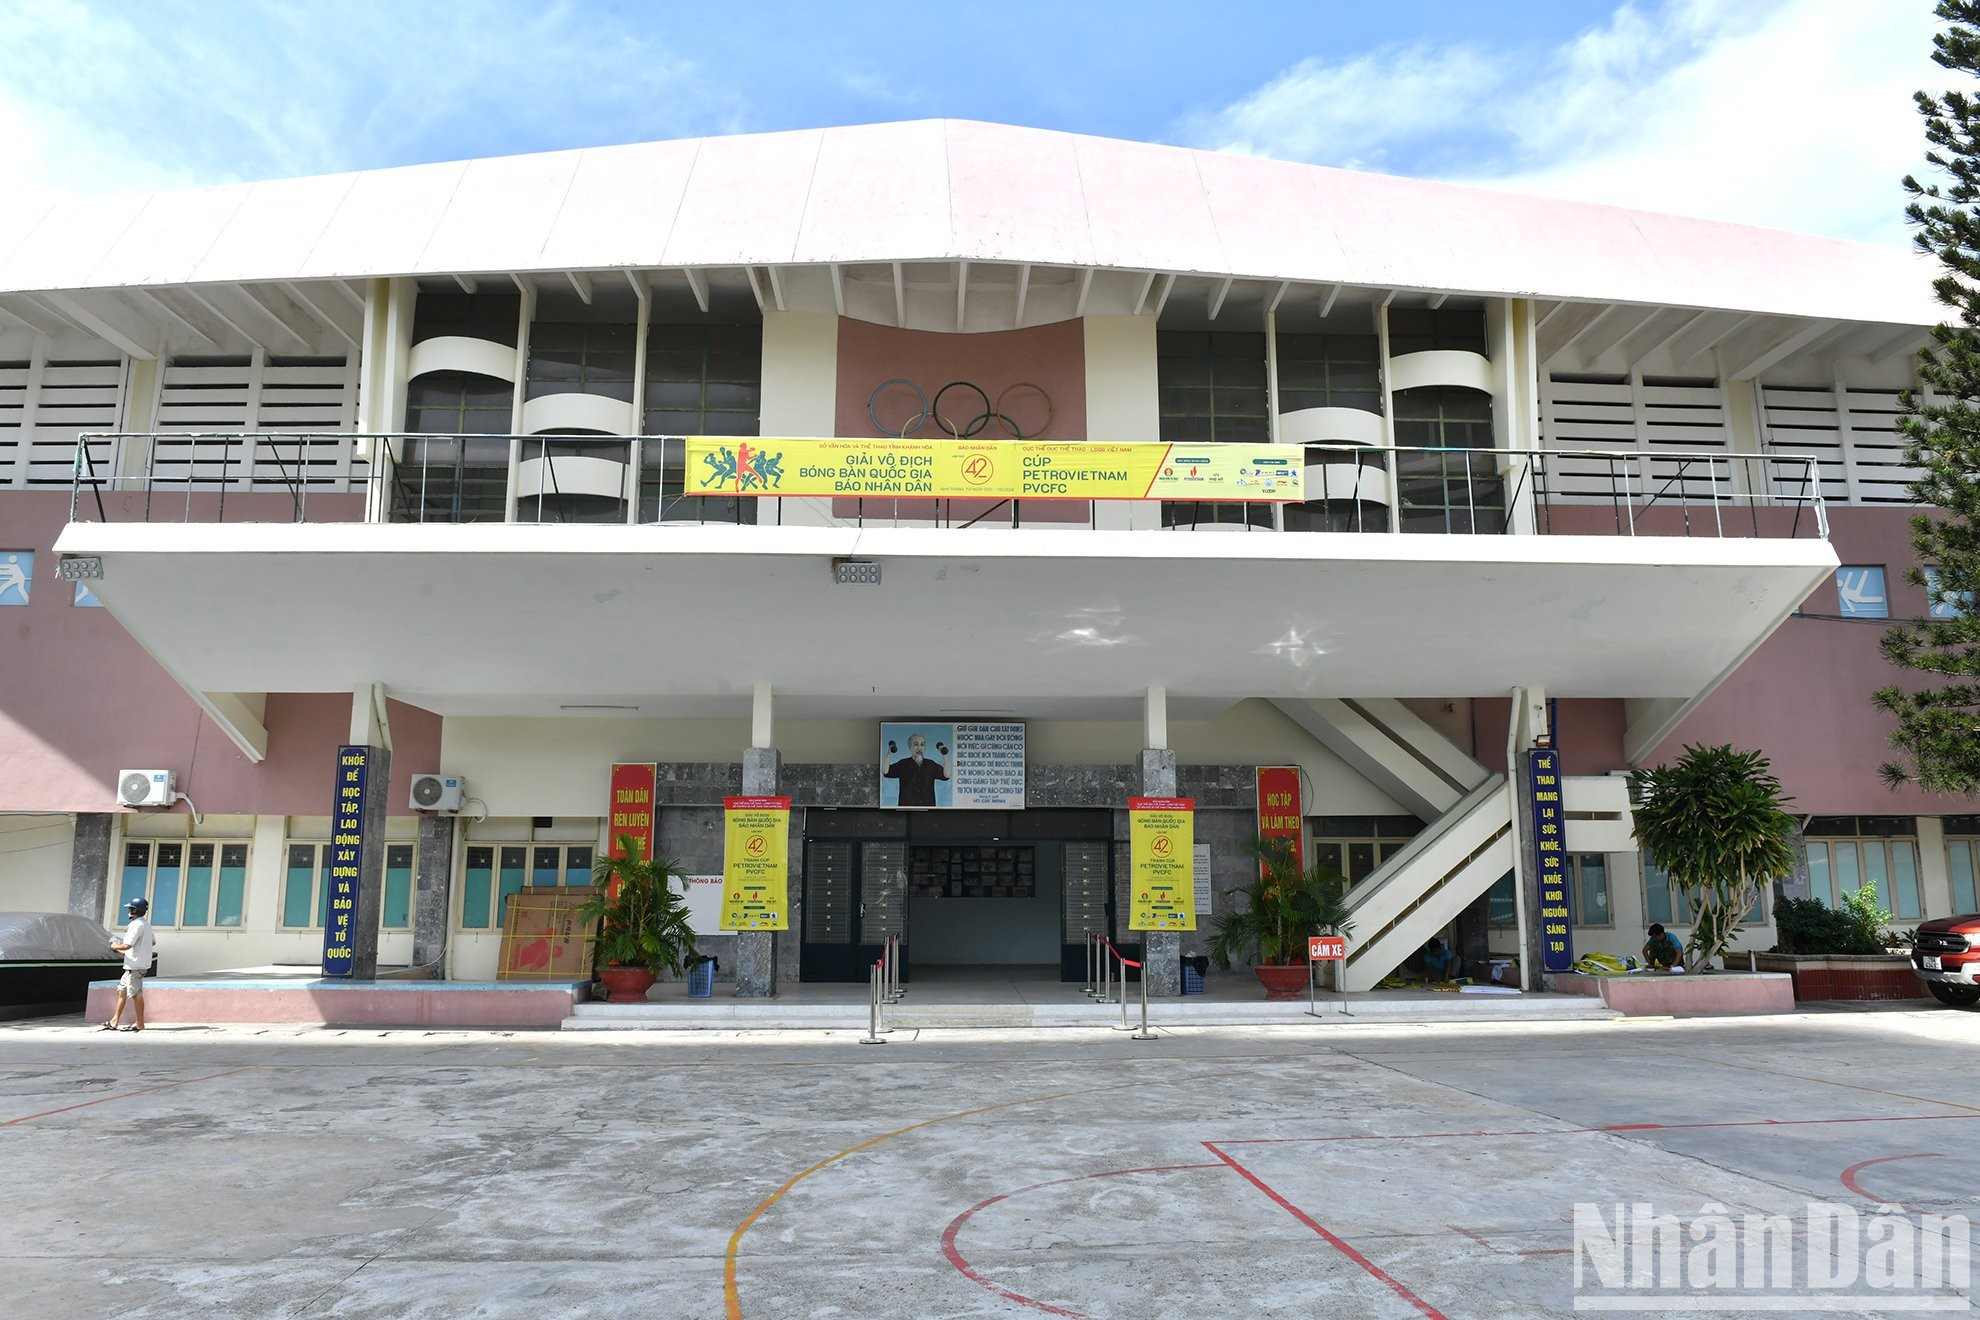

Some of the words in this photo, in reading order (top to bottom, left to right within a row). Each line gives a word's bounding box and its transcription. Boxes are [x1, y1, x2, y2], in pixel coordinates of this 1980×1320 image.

[846, 452, 872, 465] GIẢI
[900, 456, 932, 468] ĐỊCH
[1023, 455, 1051, 467] CÚP
[800, 465, 835, 478] BÓNG
[840, 466, 866, 478] BÀN
[869, 464, 906, 479] QUỐC
[910, 469, 932, 479] GIA
[965, 458, 987, 478] 42
[1023, 470, 1128, 480] PETROVIETNAM
[835, 479, 861, 491] BÁO
[865, 479, 901, 492] NHÂN
[905, 479, 932, 492] DÂN
[1023, 483, 1067, 493] PVCFC
[342, 753, 365, 766] KHỎE
[1538, 756, 1552, 769] THỂ
[346, 767, 359, 782] ĐỂ
[1537, 775, 1555, 785] THAO
[342, 788, 360, 799] HỌC
[617, 787, 634, 803] TOÀN
[635, 787, 649, 803] DÂN
[1267, 793, 1279, 809] HỌC
[1281, 790, 1292, 809] TẬP
[1537, 791, 1558, 801] MANG
[614, 810, 627, 826] RÈN
[629, 810, 649, 830] LUYỆN
[1262, 813, 1270, 829] VÀ
[1271, 813, 1284, 829] LÀM
[1285, 816, 1299, 829] THEO
[1542, 808, 1554, 820] LẠI
[340, 818, 357, 829] LAO
[1542, 821, 1557, 835] SỨC
[335, 833, 360, 848] ĐỘNG
[747, 838, 763, 853] 42
[1154, 838, 1169, 853] 42
[1540, 839, 1561, 852] KHỎE,
[337, 848, 355, 861] XÂY
[1544, 855, 1559, 868] SỨC
[333, 865, 357, 880] DỰNG
[1543, 871, 1562, 884] KHỎE
[338, 880, 350, 893] VÀ
[333, 895, 352, 910] BẢO
[337, 913, 348, 928] VỆ
[1546, 921, 1567, 935] SÁNG
[327, 944, 351, 958] QUỐC
[1311, 940, 1330, 956] CẤM
[1332, 945, 1342, 956] XE
[1550, 941, 1564, 953] TẠO
